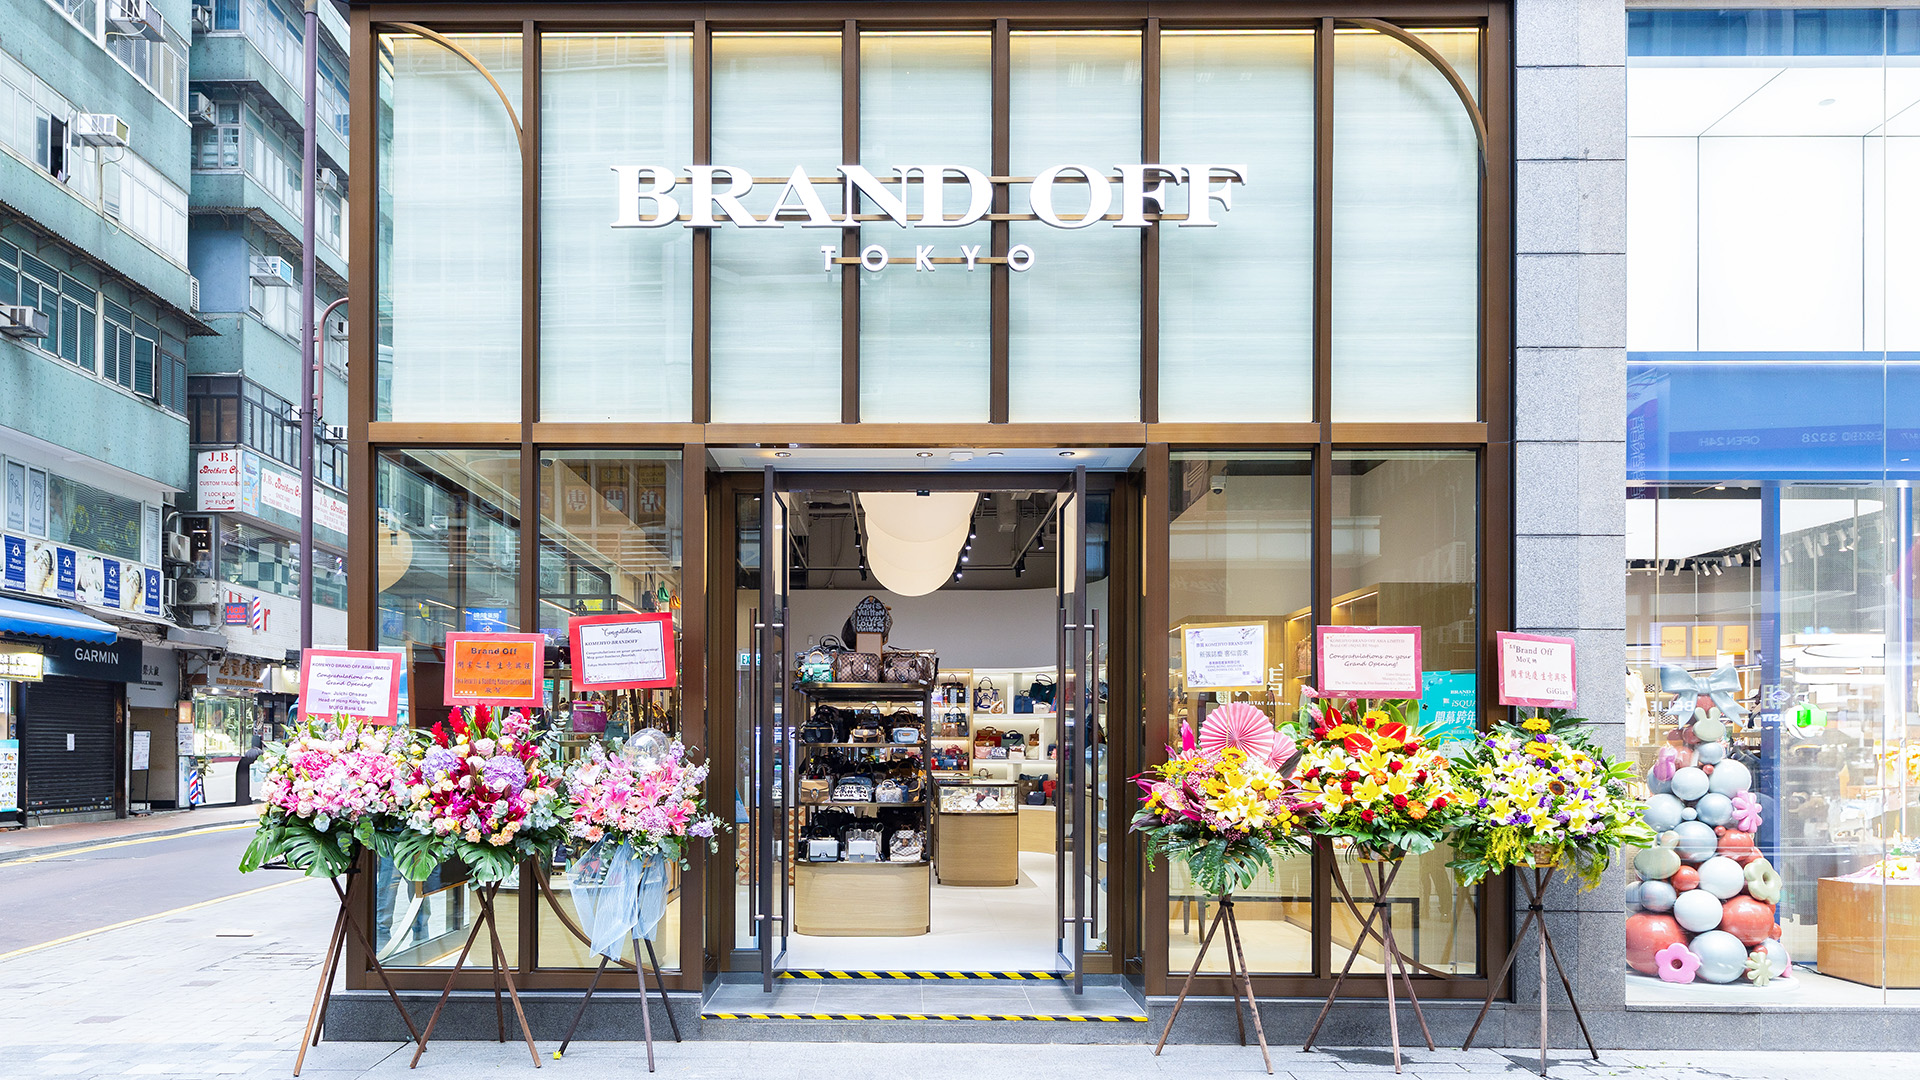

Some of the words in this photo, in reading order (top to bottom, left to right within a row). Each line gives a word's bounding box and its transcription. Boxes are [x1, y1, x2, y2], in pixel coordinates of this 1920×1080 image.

[610, 164, 994, 229] BRAND
[1029, 163, 1249, 229] OFF
[820, 244, 1035, 273] TOKYO
[208, 452, 233, 462] J.B.
[199, 465, 227, 475] Brothers
[226, 606, 246, 614] Hair
[471, 647, 500, 655] Brand
[74, 648, 119, 665] GARMIN
